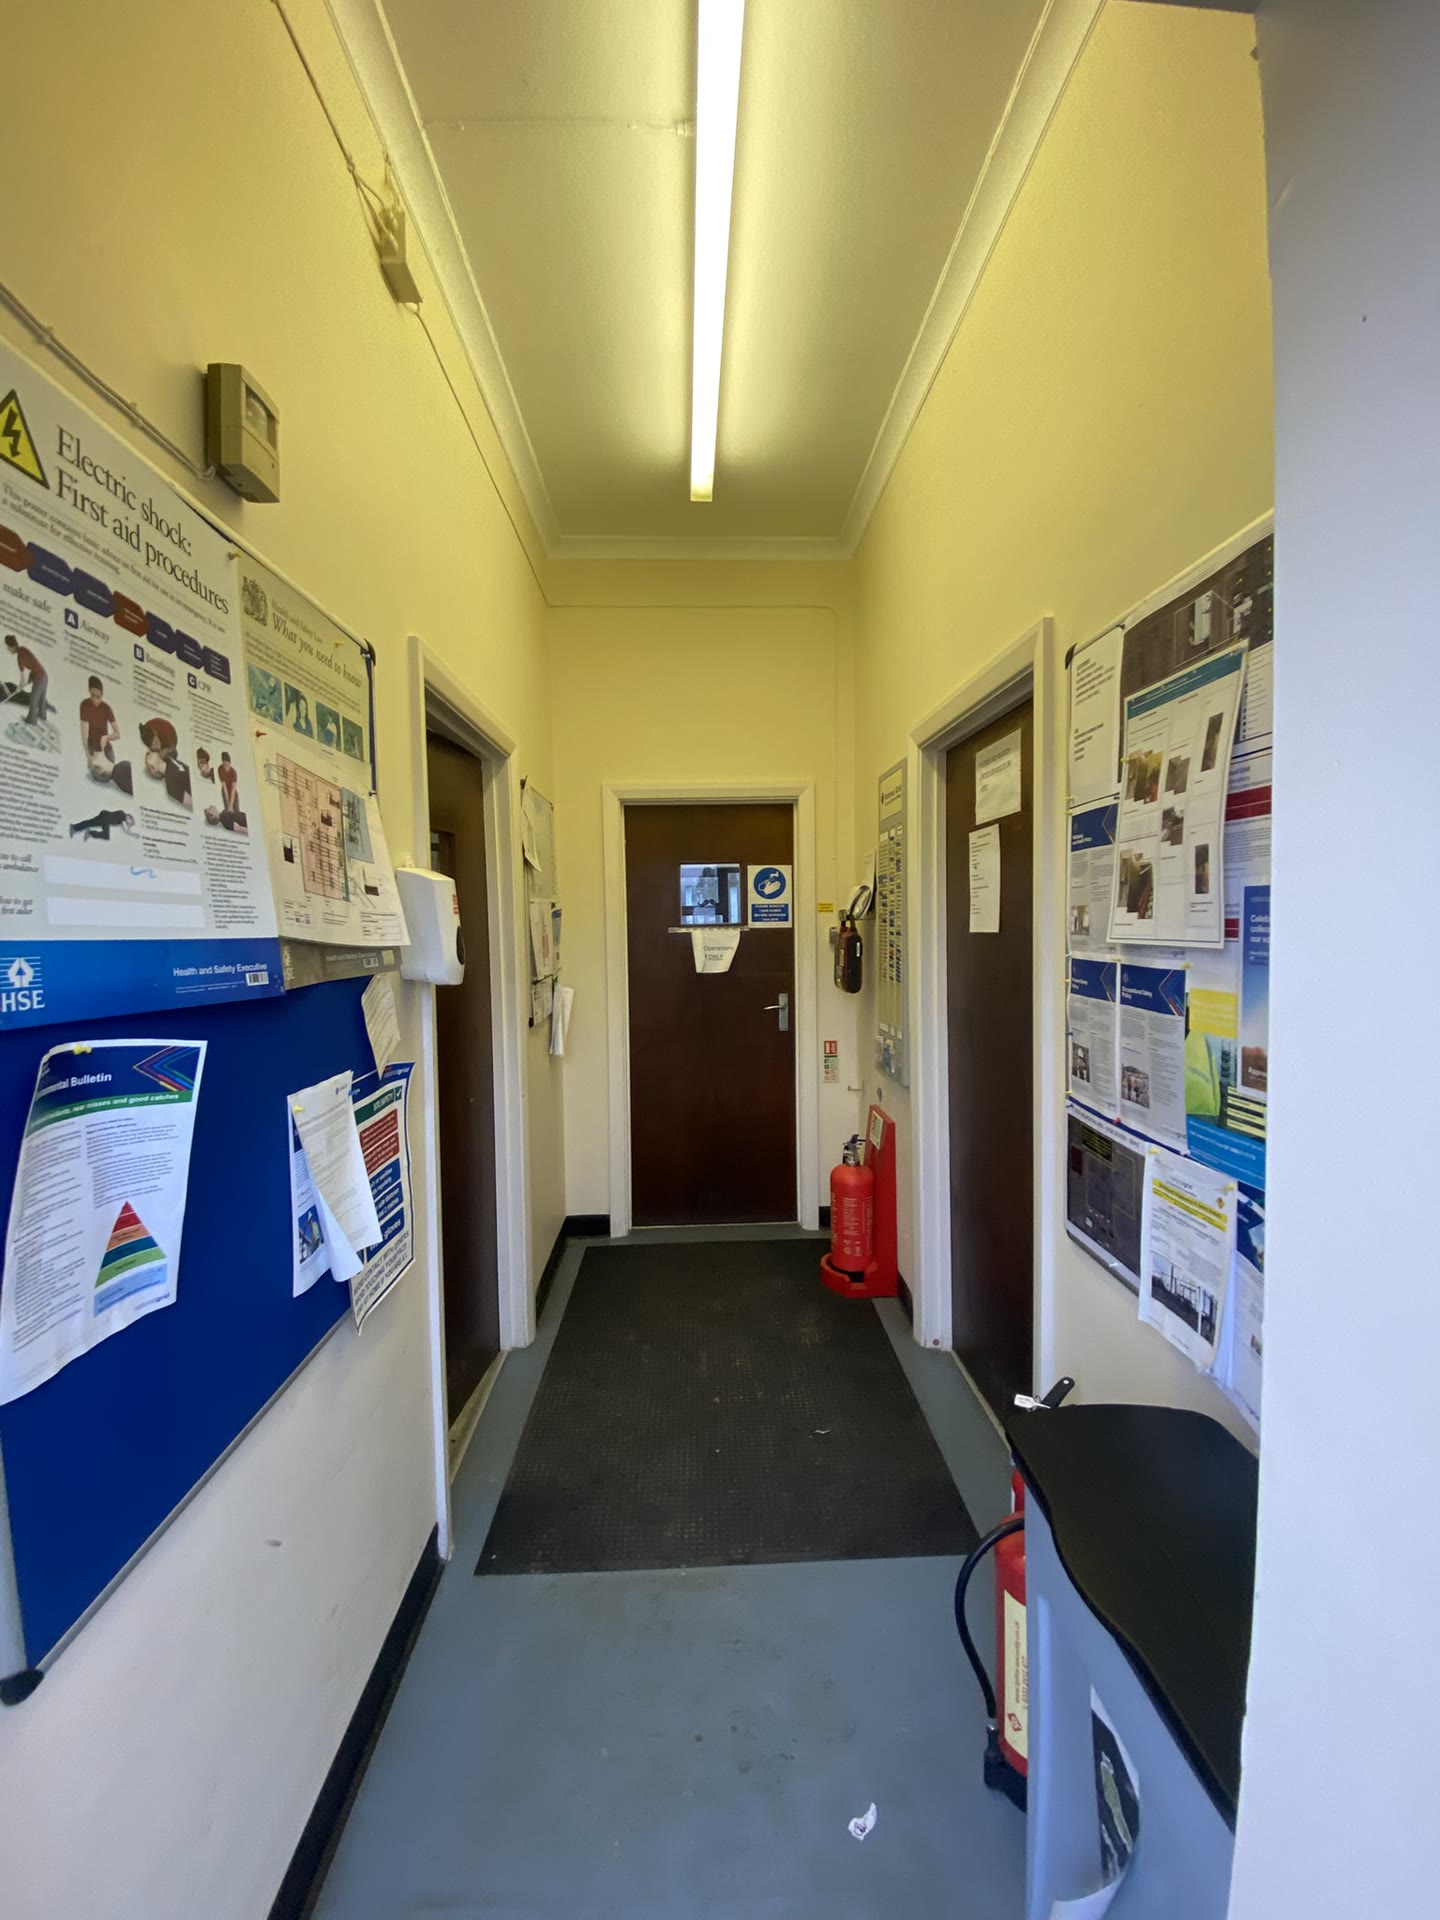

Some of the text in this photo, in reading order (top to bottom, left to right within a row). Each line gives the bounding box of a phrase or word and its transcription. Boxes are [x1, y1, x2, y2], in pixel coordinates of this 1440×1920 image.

[56, 424, 192, 556] Electric shock:
[56, 467, 229, 614] First aid procedures
[4, 584, 52, 613] make safe
[67, 611, 76, 625] A
[80, 620, 110, 643] Airway
[272, 612, 297, 644] What
[299, 636, 314, 655] you
[315, 651, 333, 670] need
[136, 647, 142, 659] B
[189, 676, 196, 686] C
[173, 963, 268, 976] Health and Safety Executive
[1, 990, 45, 1012] HSE
[70, 1072, 112, 1087] Bulletin
[129, 1096, 148, 1104] good
[150, 1092, 179, 1101] catches
[383, 1219, 401, 1240] gloves
